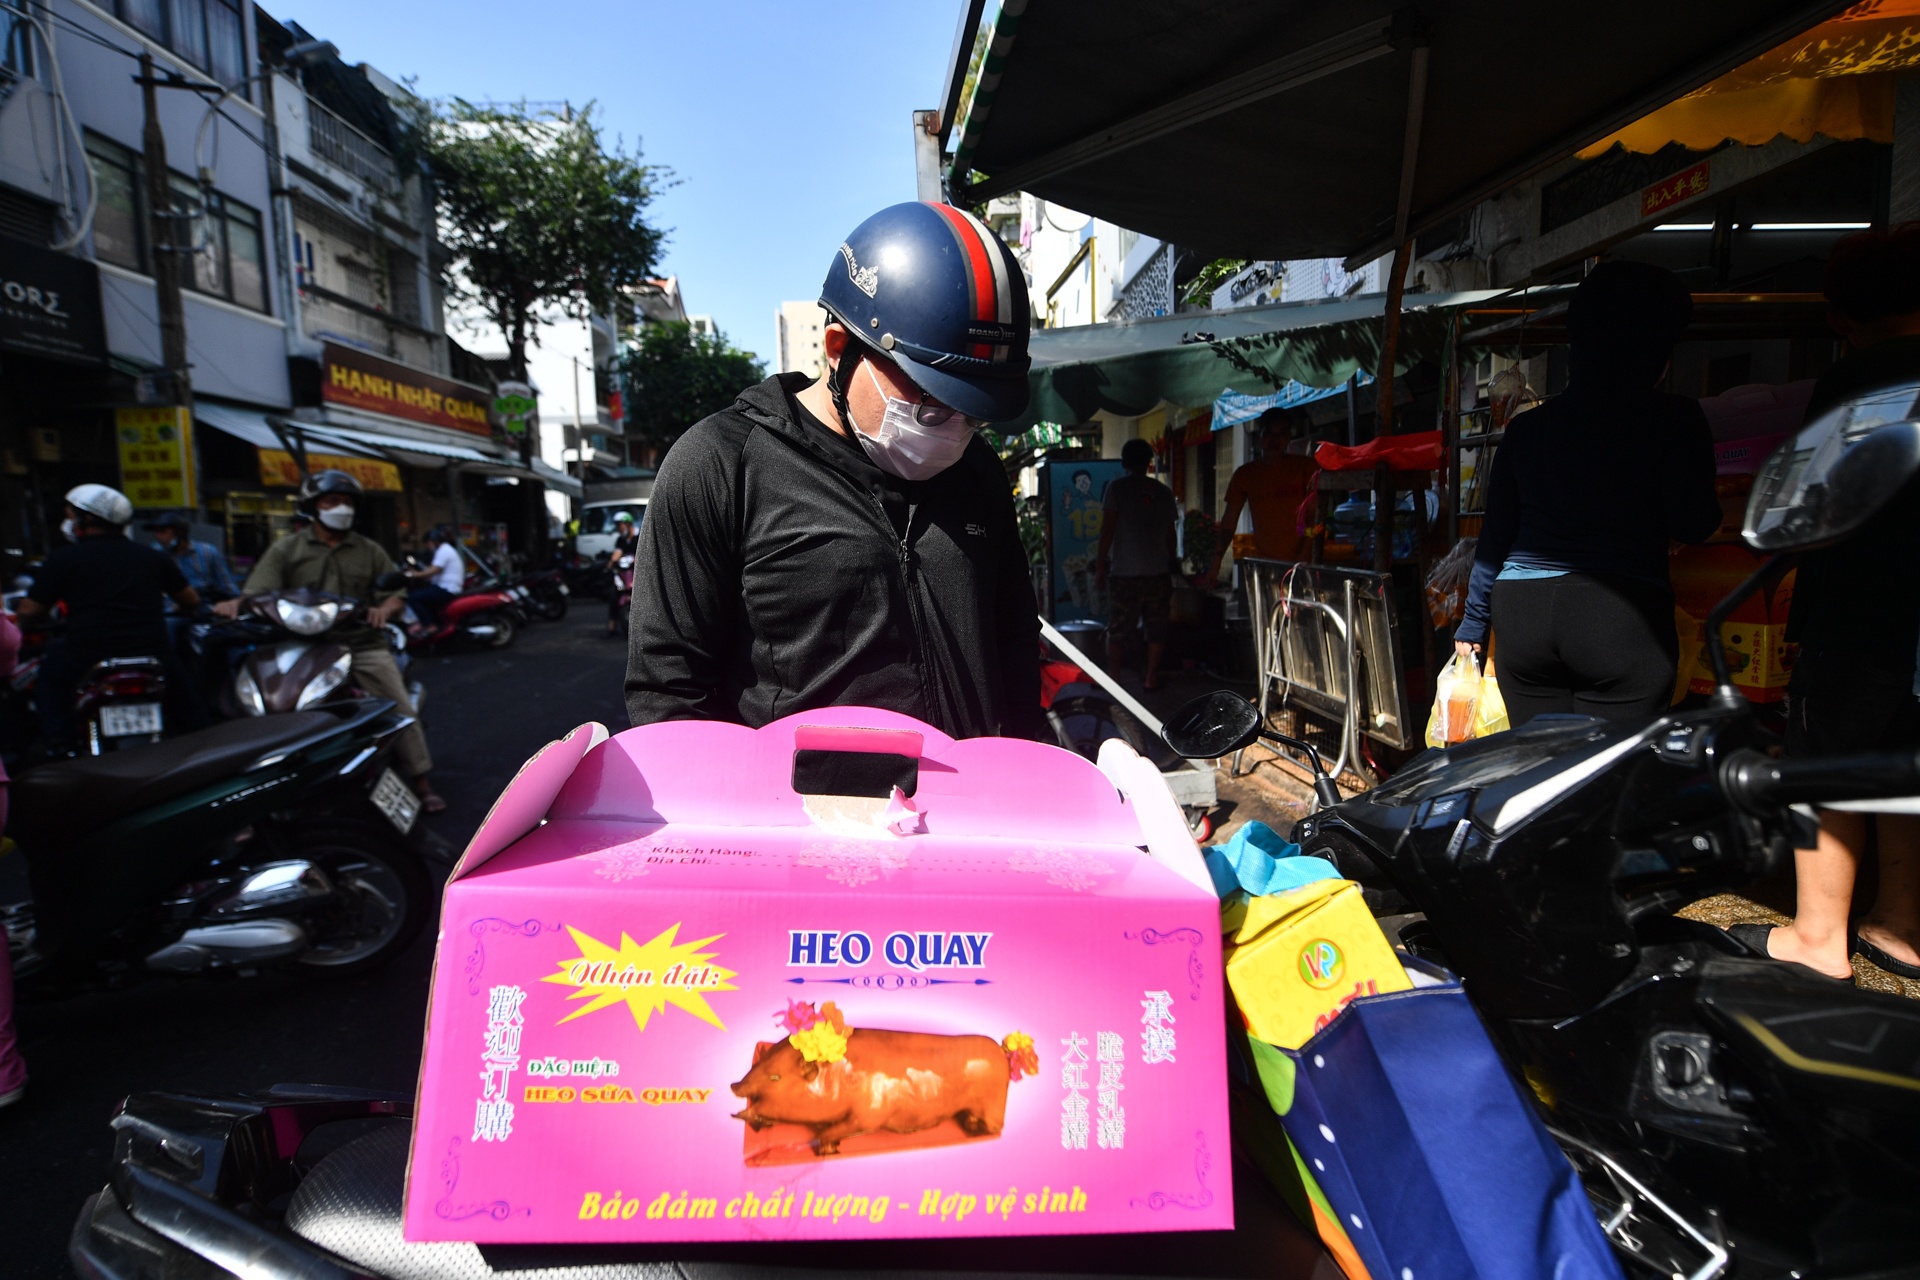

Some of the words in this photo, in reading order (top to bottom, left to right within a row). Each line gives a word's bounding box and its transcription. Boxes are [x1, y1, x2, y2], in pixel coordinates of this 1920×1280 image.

[1646, 171, 1703, 210] 出入平安
[330, 364, 395, 398] HẠNH
[396, 382, 443, 416] NHẬT
[1722, 447, 1750, 461] QUAY
[652, 846, 704, 855] Khách
[709, 848, 758, 858] Hàng:
[787, 930, 872, 967] HEO
[884, 931, 993, 972] QUAY
[570, 961, 653, 990] Nhận
[663, 962, 720, 991] đặt:
[1140, 990, 1176, 1064] 承接
[528, 1057, 570, 1078] ĐẶC
[572, 1057, 619, 1078] BIỆT:
[524, 1086, 576, 1103] HEO
[581, 1083, 637, 1103] SỮA
[640, 1088, 713, 1106] QUAY
[578, 1190, 640, 1220] Bảo
[646, 1190, 718, 1219] đảm
[724, 1186, 795, 1219] chất
[801, 1190, 890, 1224] lượng
[918, 1188, 977, 1223] Hợp
[984, 1186, 1018, 1221] vệ
[1022, 1185, 1088, 1214] sinh
